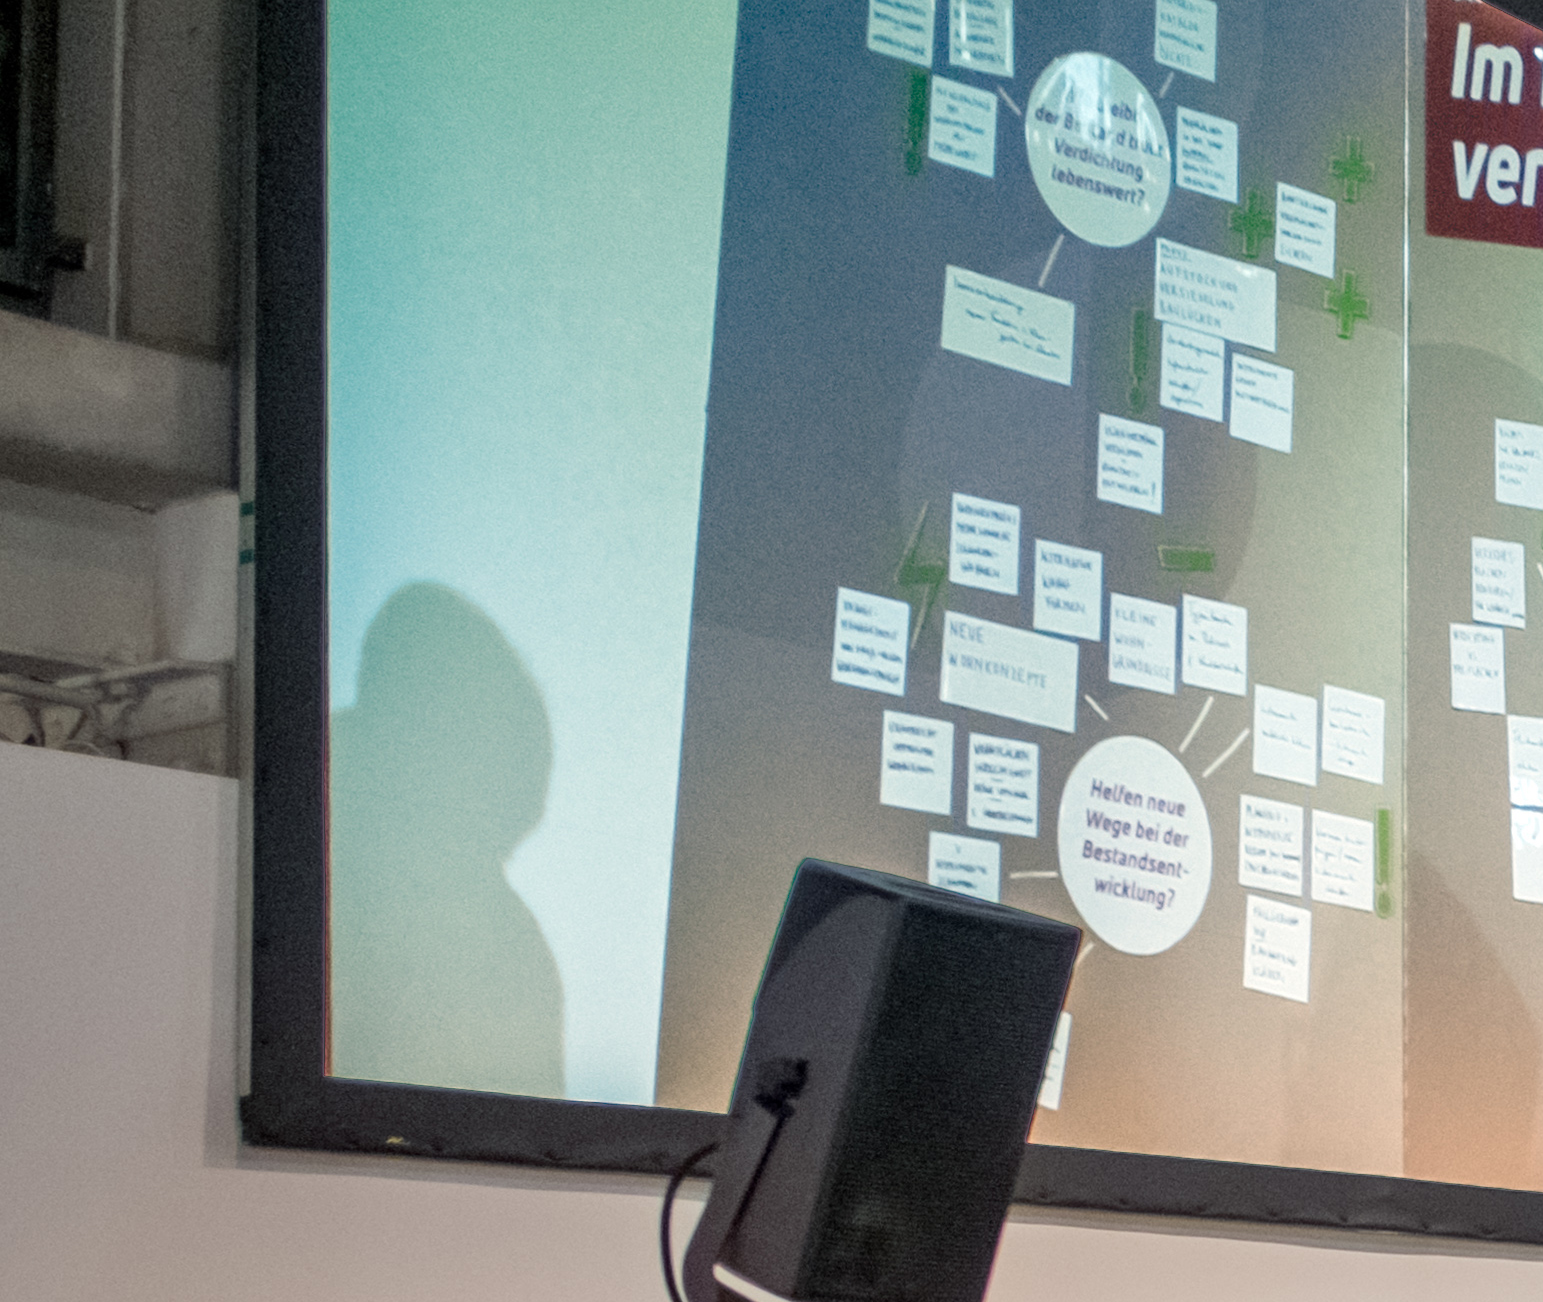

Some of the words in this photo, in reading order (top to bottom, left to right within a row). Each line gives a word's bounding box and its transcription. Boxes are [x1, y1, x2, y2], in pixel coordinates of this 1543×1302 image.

[1450, 22, 1524, 105] Im
[1090, 777, 1143, 808] Helfen
[1147, 796, 1186, 818] neue
[1086, 808, 1132, 839] Wege
[1135, 820, 1160, 842] bei
[1163, 828, 1189, 848] der
[1082, 839, 1190, 879] Bestandsent-
[1094, 876, 1176, 911] wicklung?
